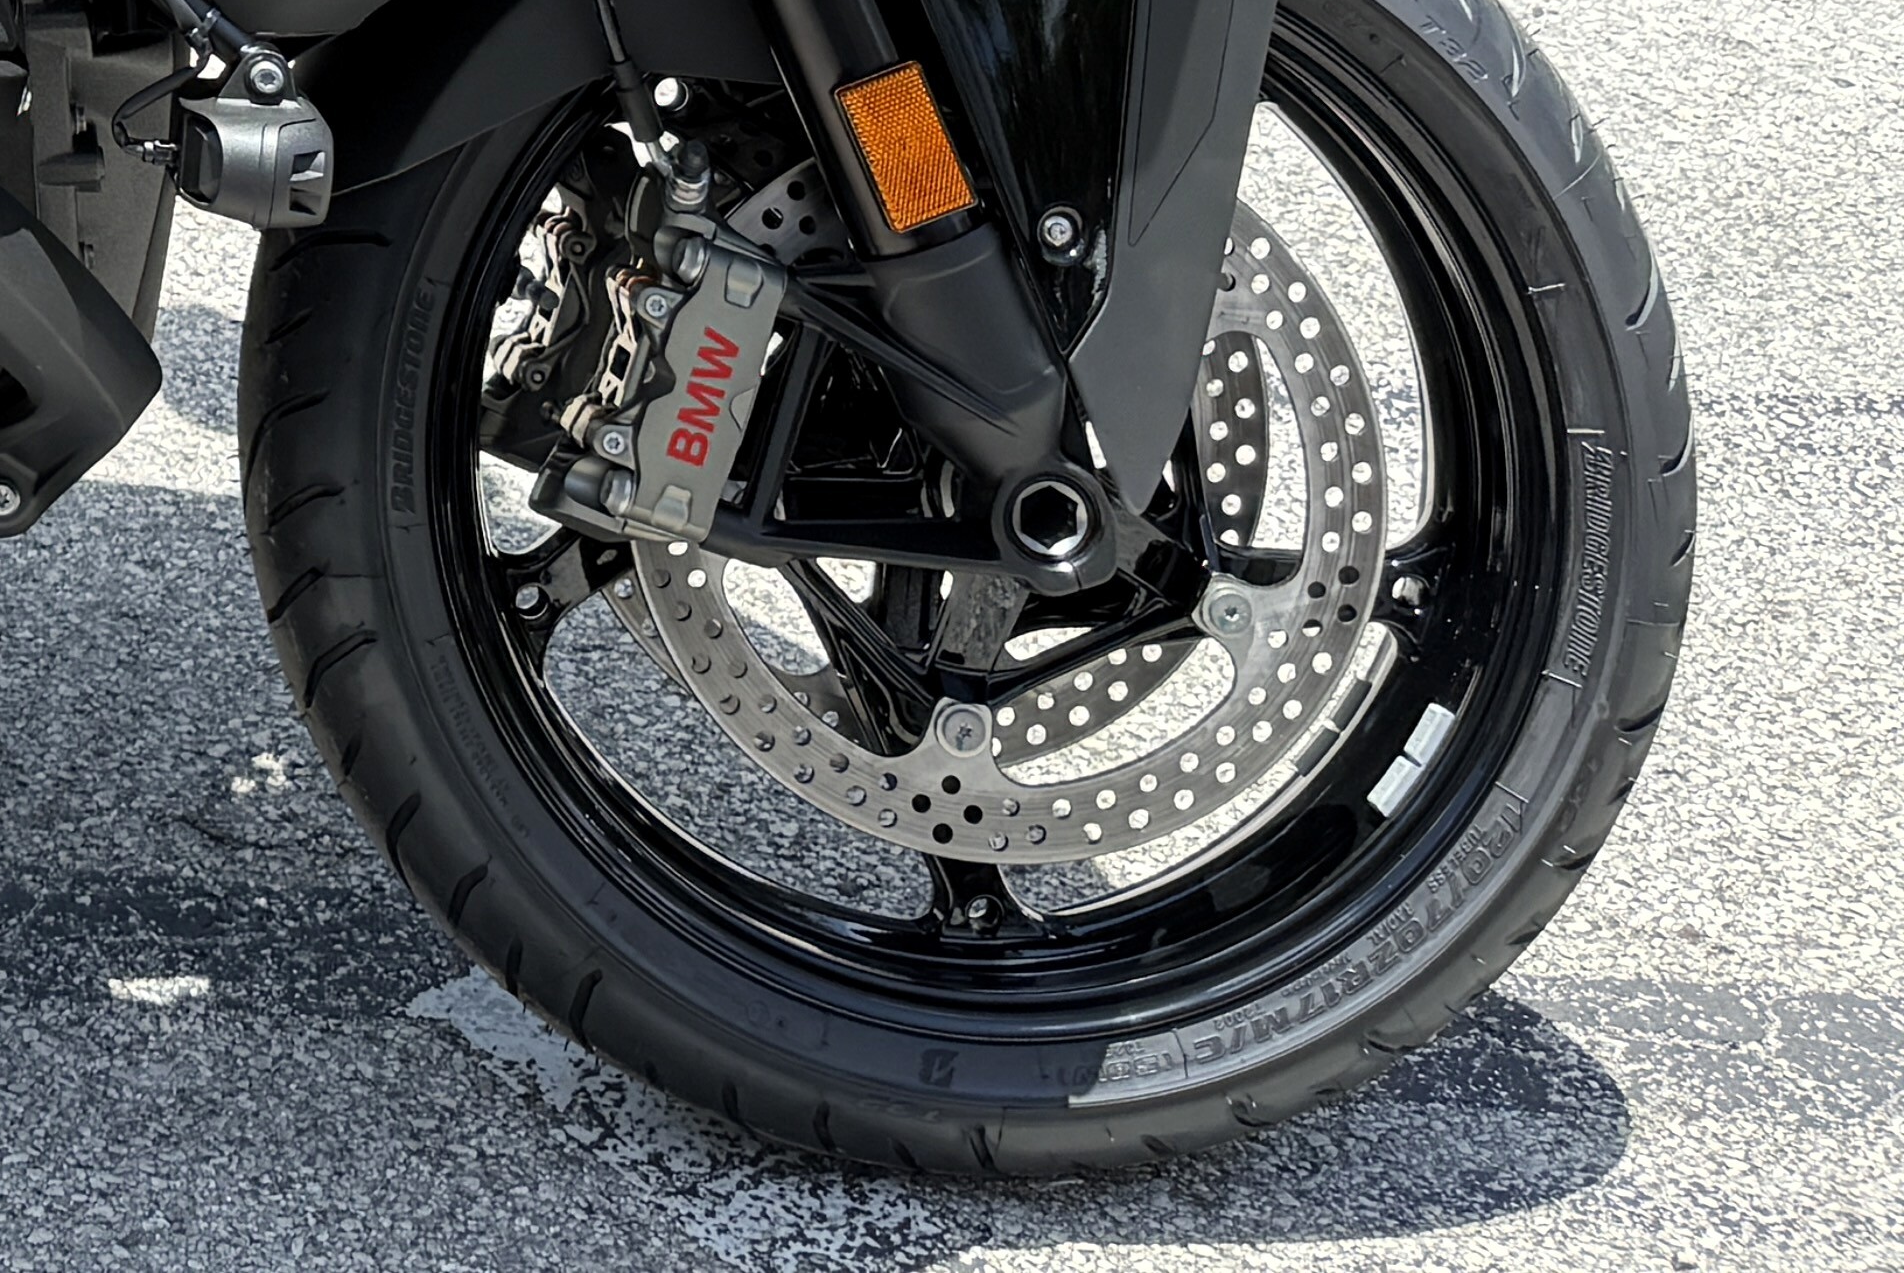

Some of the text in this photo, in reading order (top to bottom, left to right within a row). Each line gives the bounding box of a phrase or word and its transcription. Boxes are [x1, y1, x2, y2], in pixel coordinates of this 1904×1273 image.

[391, 284, 437, 516] BRIDGESTONE
[666, 326, 740, 468] BMW
[1563, 440, 1614, 677] BRIDGESTONE
